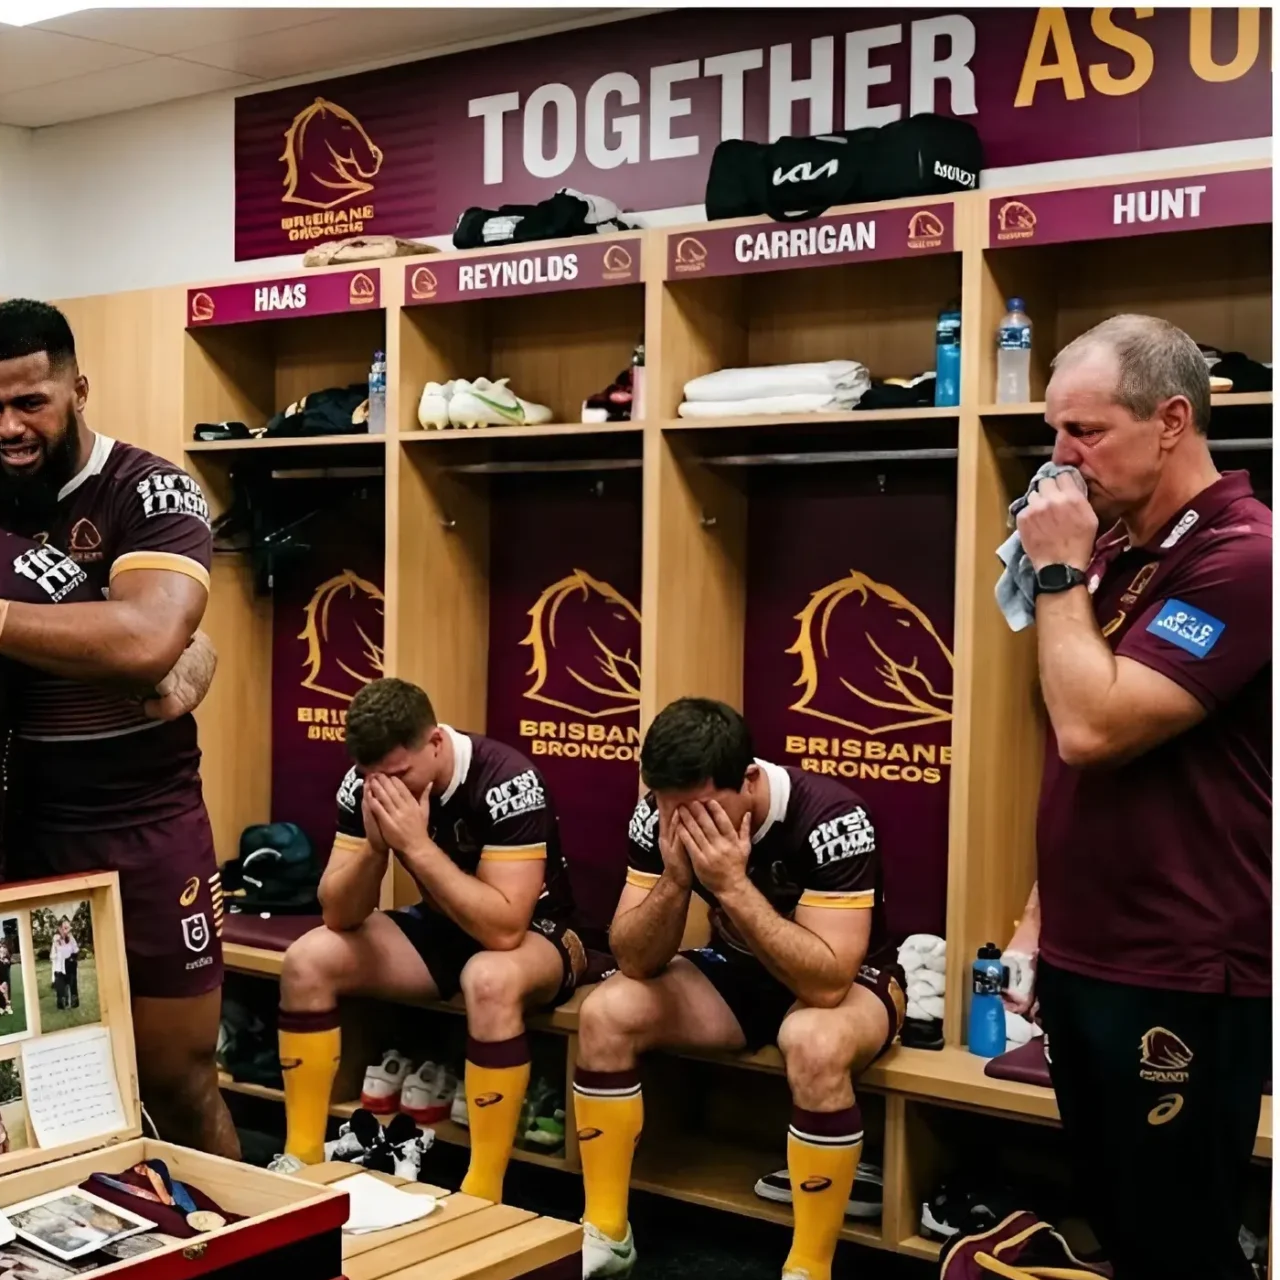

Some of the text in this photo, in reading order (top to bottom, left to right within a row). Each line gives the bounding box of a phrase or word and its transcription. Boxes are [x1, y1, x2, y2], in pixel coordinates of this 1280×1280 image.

[468, 13, 979, 185] TOGETHER
[1013, 8, 1155, 107] AS
[1113, 185, 1207, 225] HUNT
[734, 220, 876, 263] CARRIGAN
[458, 253, 579, 291] REYNOLDS
[254, 283, 307, 312] HAAS
[785, 735, 952, 765] BRISBANE
